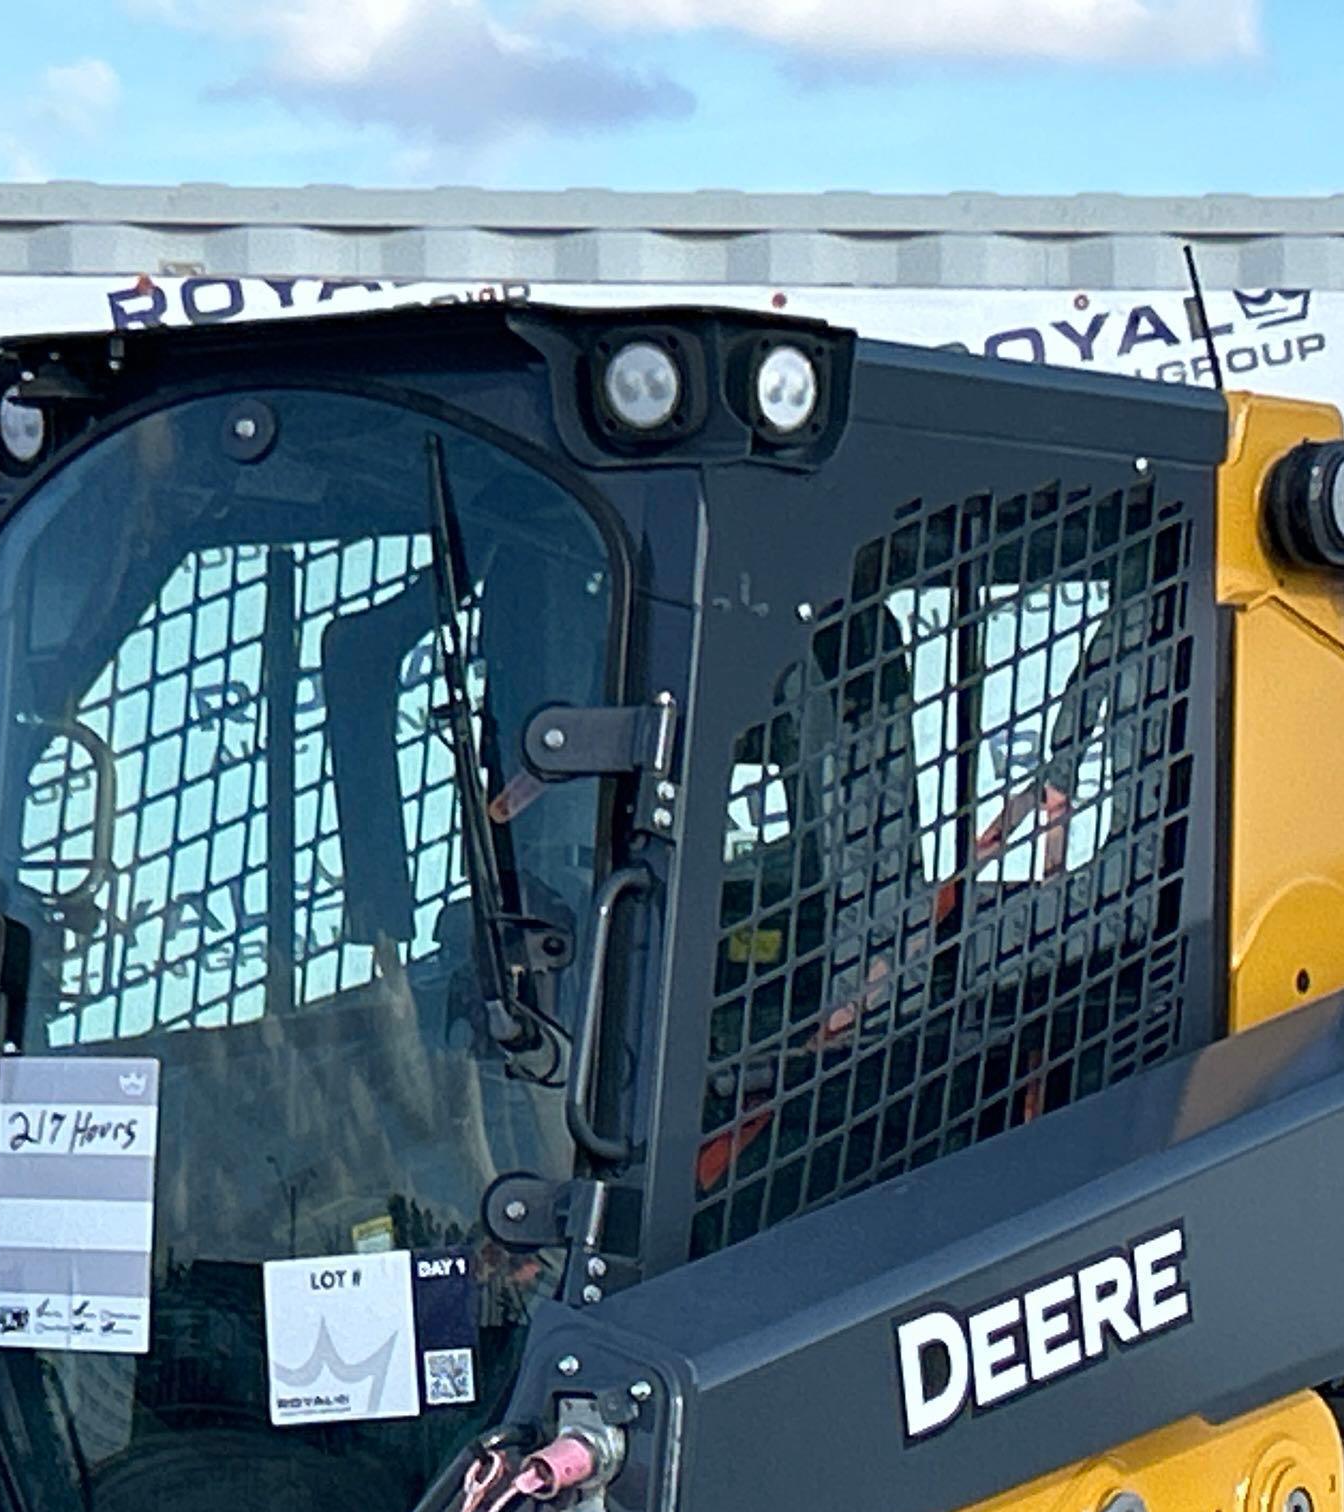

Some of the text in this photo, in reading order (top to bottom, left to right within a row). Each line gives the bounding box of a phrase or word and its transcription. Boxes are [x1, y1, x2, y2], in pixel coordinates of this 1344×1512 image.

[984, 297, 1234, 366] OYAL
[8, 1109, 139, 1153] 217 Hours
[310, 1270, 347, 1290] LOT
[417, 1258, 452, 1278] DAY
[898, 1229, 1188, 1436] DEERE
